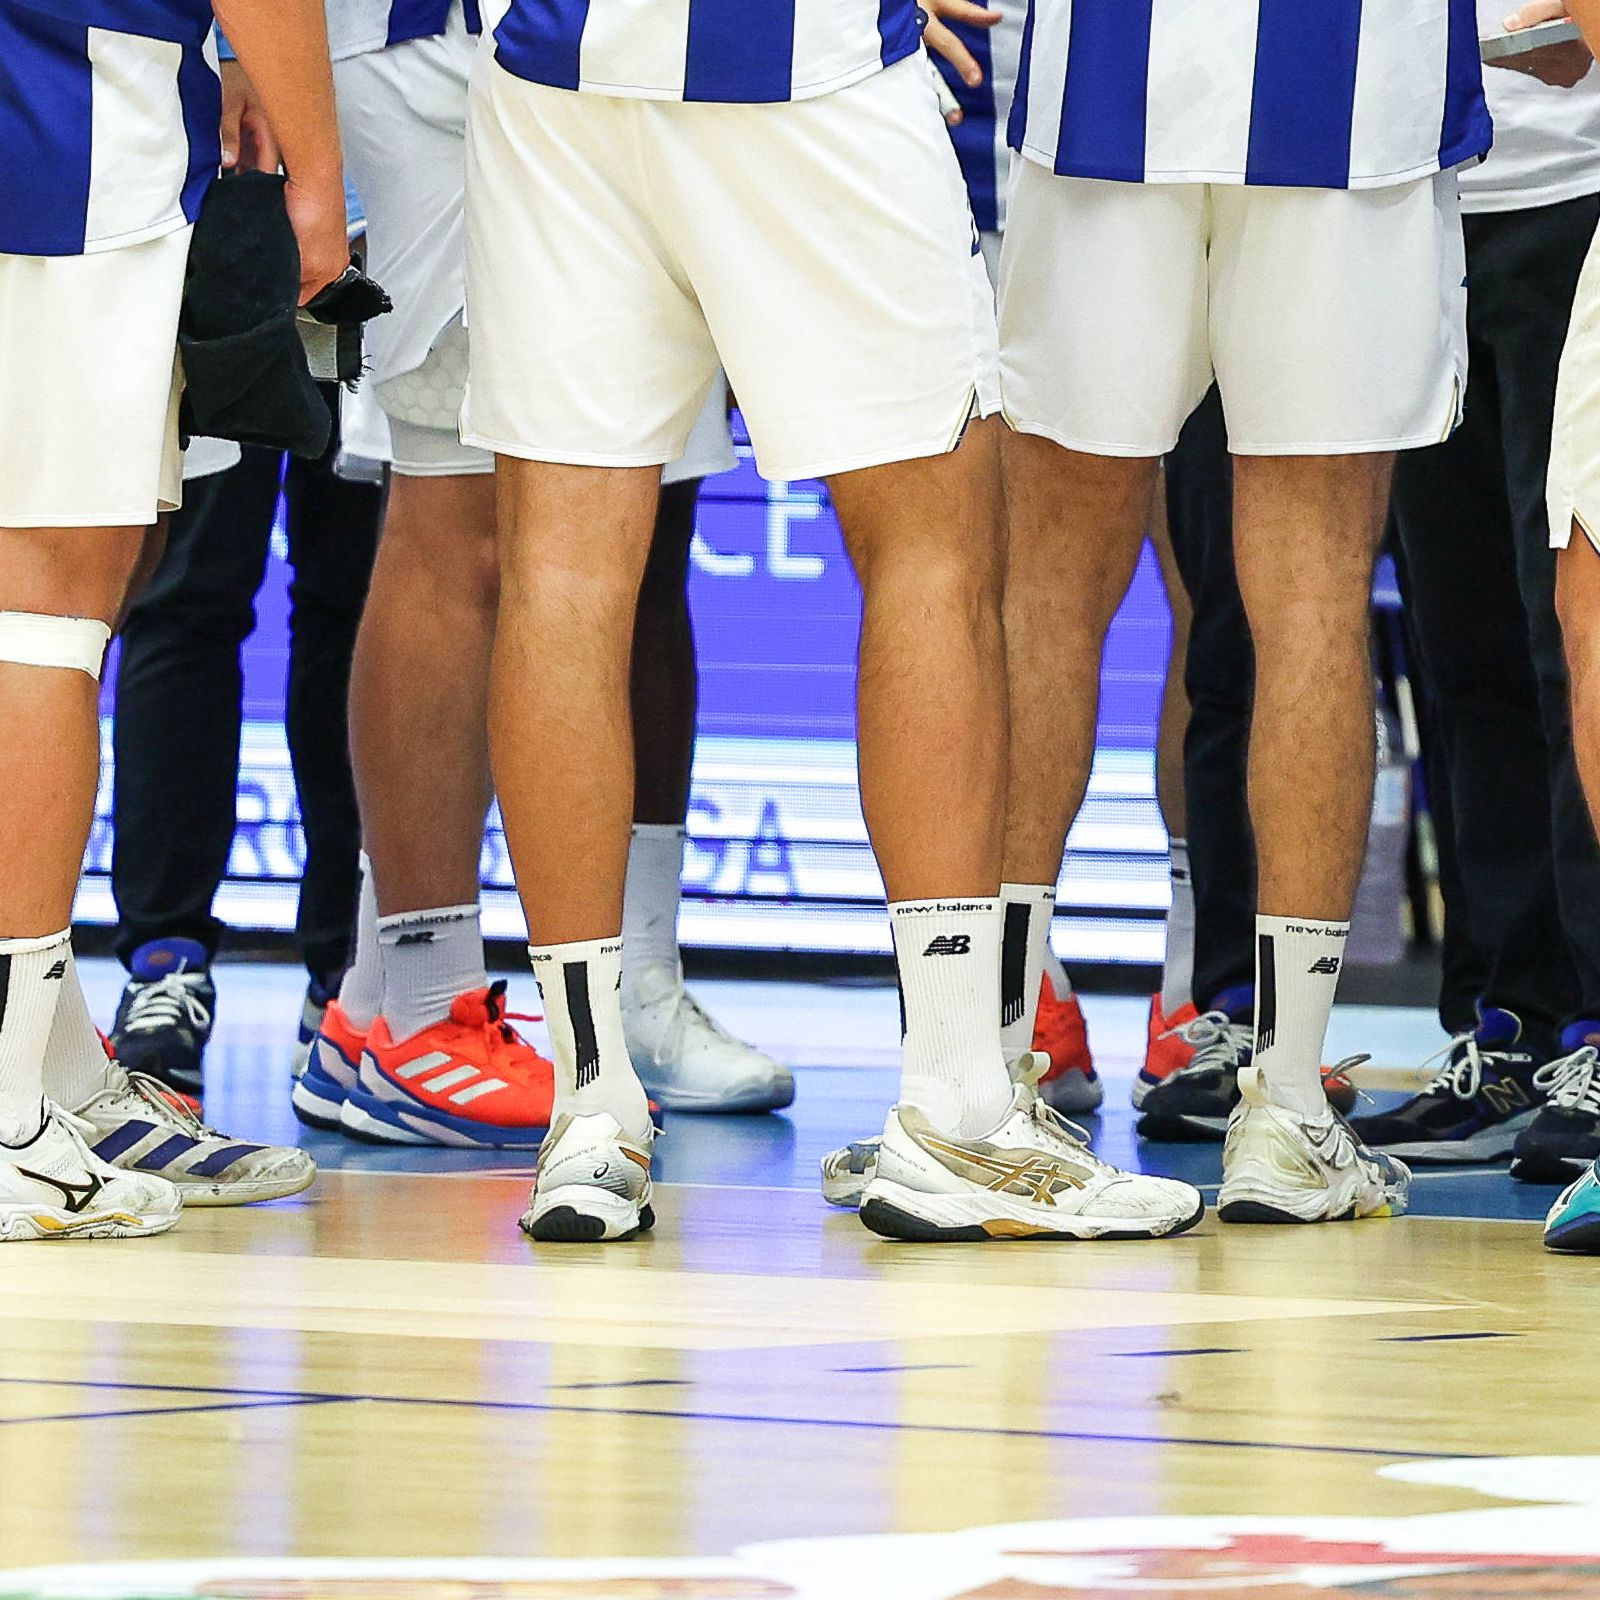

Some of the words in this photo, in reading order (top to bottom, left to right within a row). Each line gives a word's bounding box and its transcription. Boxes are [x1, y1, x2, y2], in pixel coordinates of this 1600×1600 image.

[896, 905, 935, 916] new
[936, 902, 993, 913] balance
[1285, 924, 1324, 936] new
